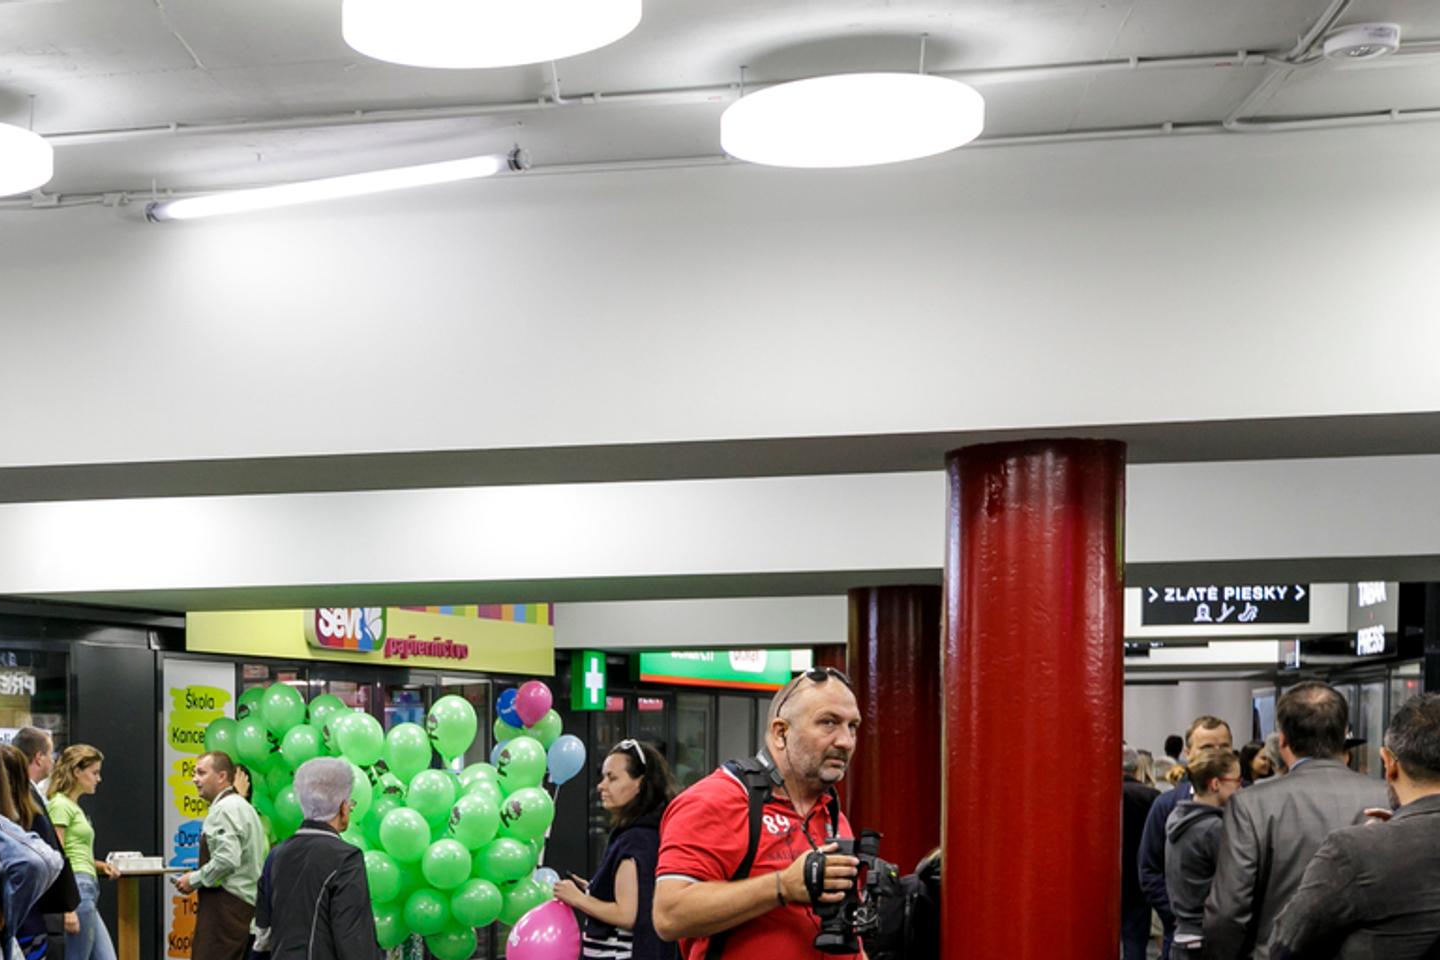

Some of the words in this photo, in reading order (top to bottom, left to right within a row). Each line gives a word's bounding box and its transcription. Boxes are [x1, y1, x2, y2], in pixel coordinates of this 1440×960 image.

[1164, 586, 1218, 601] ZLATÉ
[1224, 585, 1288, 601] PIESKY
[185, 688, 215, 710] Škola
